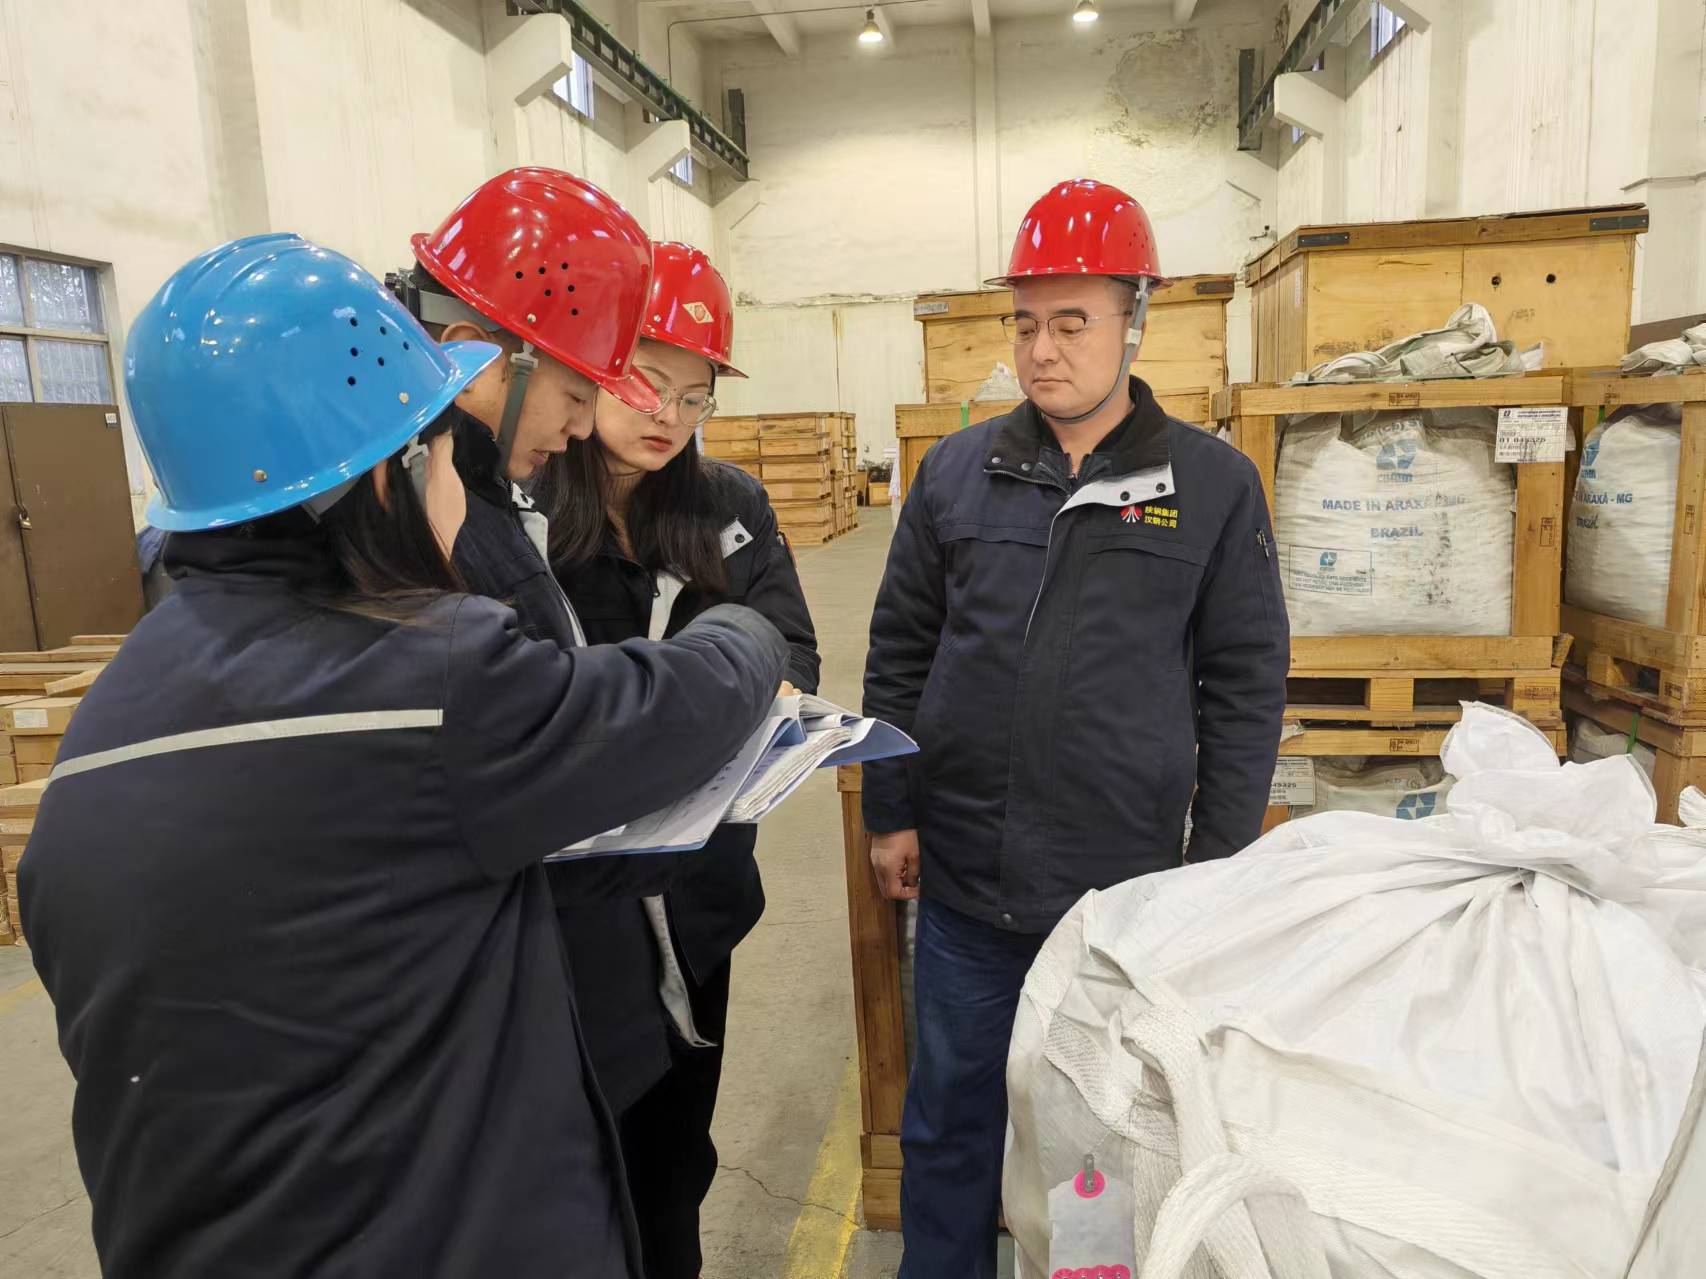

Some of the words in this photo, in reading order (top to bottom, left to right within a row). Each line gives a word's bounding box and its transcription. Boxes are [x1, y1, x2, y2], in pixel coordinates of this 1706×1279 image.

[1322, 498, 1361, 511] MADE
[1366, 500, 1381, 511] IN
[1616, 493, 1633, 504] MG
[1370, 525, 1424, 539] BRAZIL
